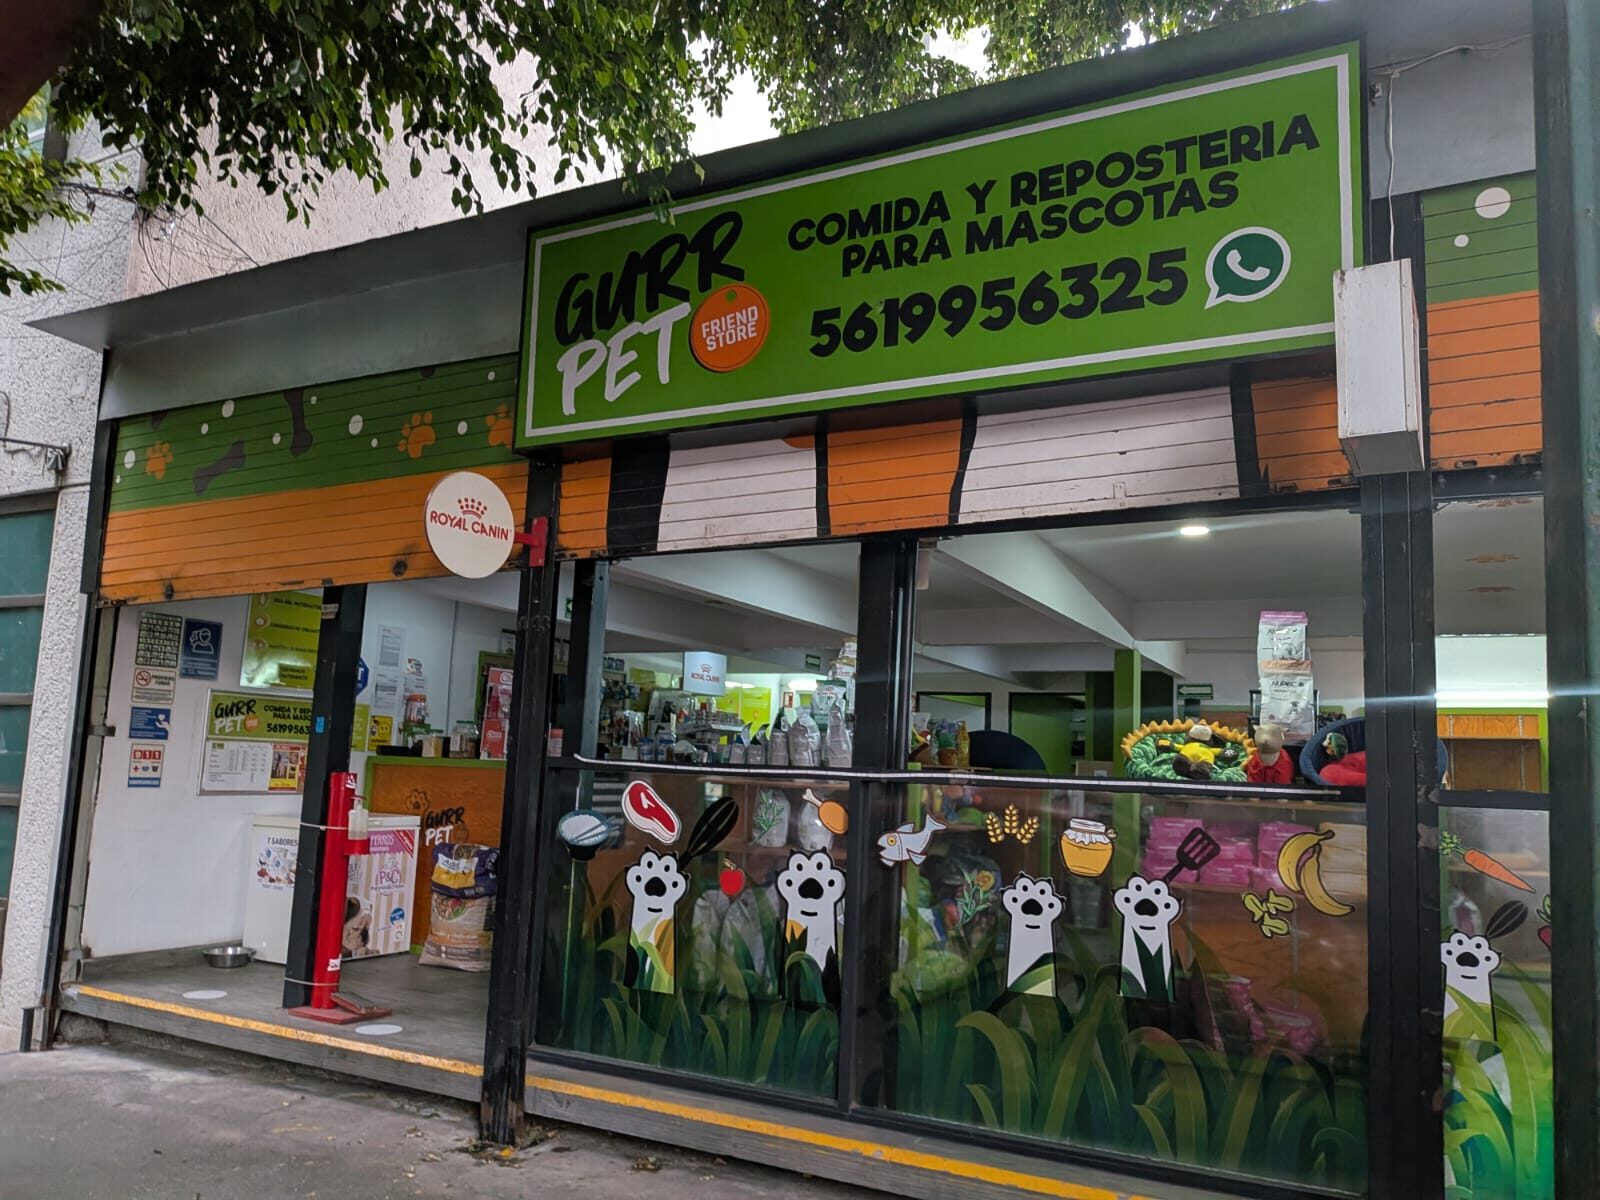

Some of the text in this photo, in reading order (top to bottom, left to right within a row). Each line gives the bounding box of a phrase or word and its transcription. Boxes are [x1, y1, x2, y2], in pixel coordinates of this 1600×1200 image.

[788, 113, 1320, 251] COMIDA Y REPOSTERIA
[841, 171, 1239, 278] PARA MASCOTAS
[554, 211, 745, 346] GURR
[809, 247, 1189, 358] 5619956325
[701, 305, 759, 339] FRIEND
[706, 321, 757, 352] STORE
[556, 302, 692, 416] PET
[429, 510, 509, 541] ROYAL CANIN
[214, 699, 257, 719] GURR
[264, 704, 291, 713] COMIDA
[273, 712, 291, 720] PARA
[214, 715, 246, 735] PET
[425, 806, 465, 829] GURR
[425, 825, 454, 847] PET
